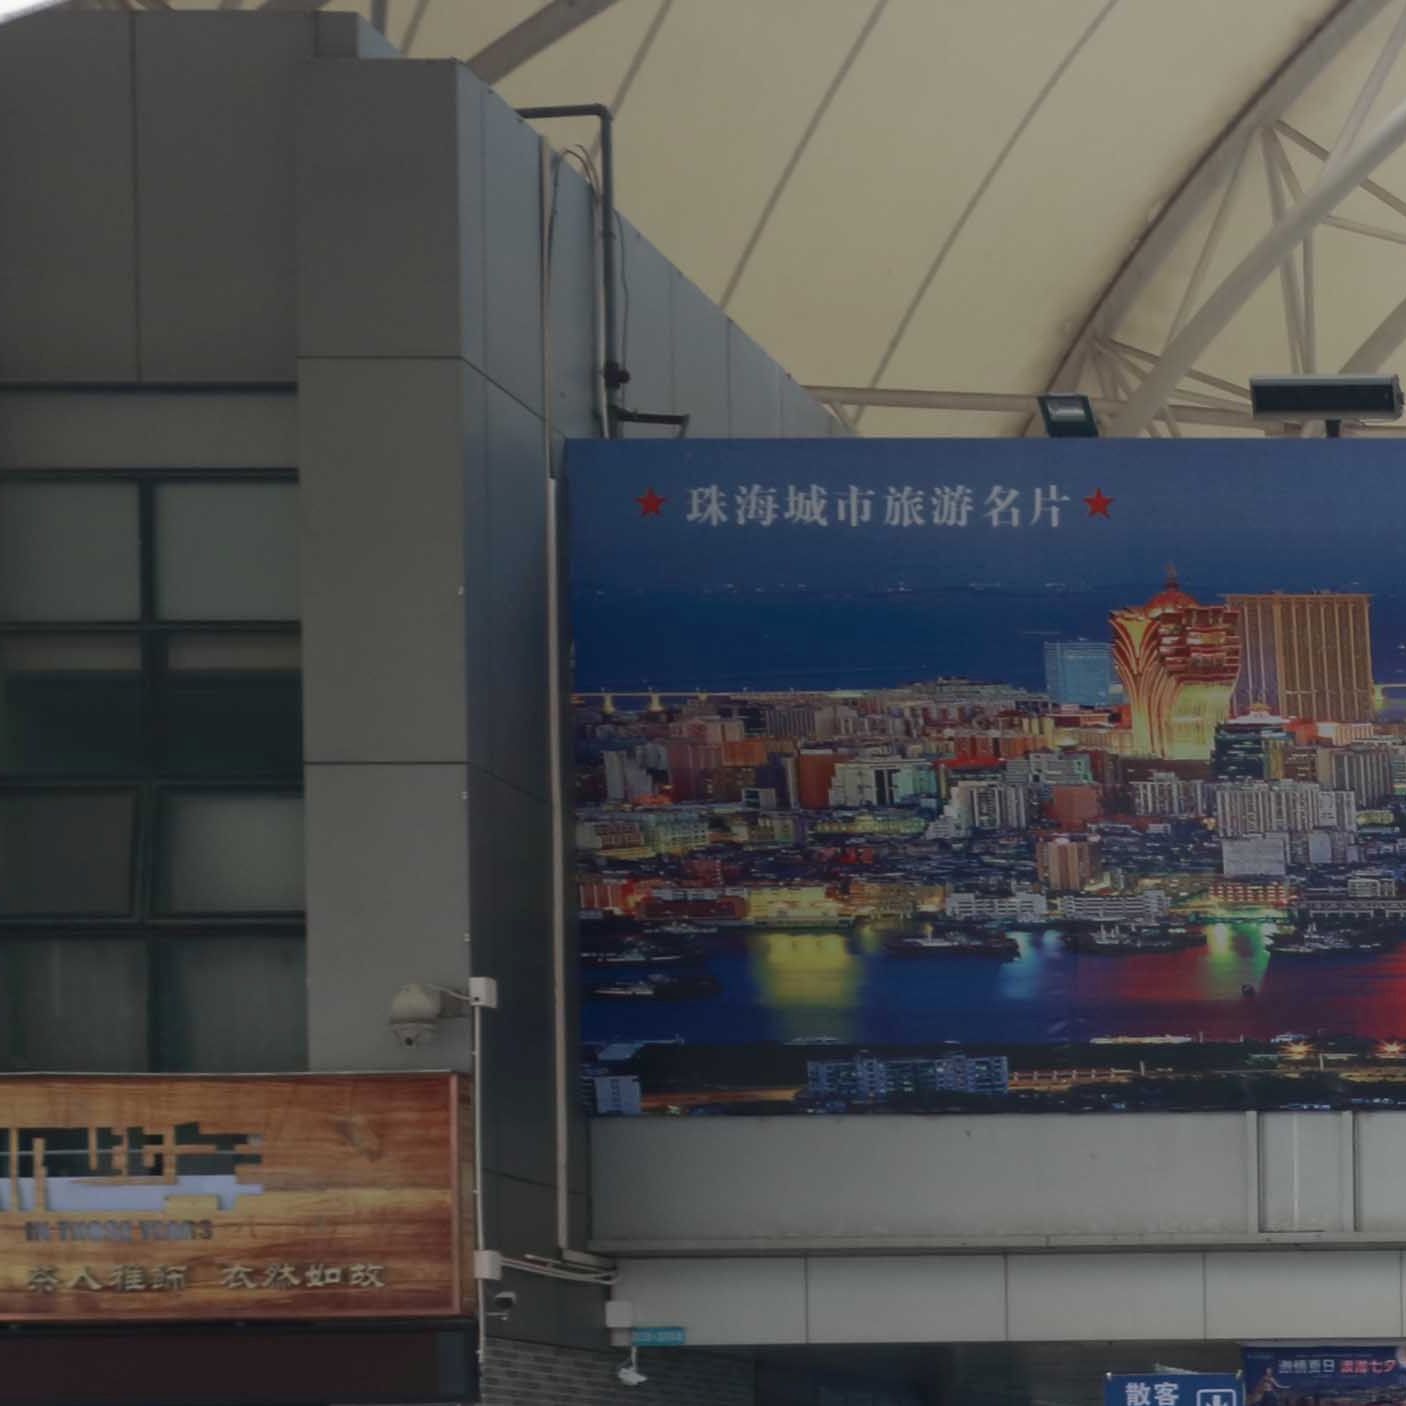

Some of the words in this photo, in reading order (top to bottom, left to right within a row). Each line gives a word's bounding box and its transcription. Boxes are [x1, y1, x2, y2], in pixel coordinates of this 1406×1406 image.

[686, 484, 1071, 528] 珠海城市旅游名片
